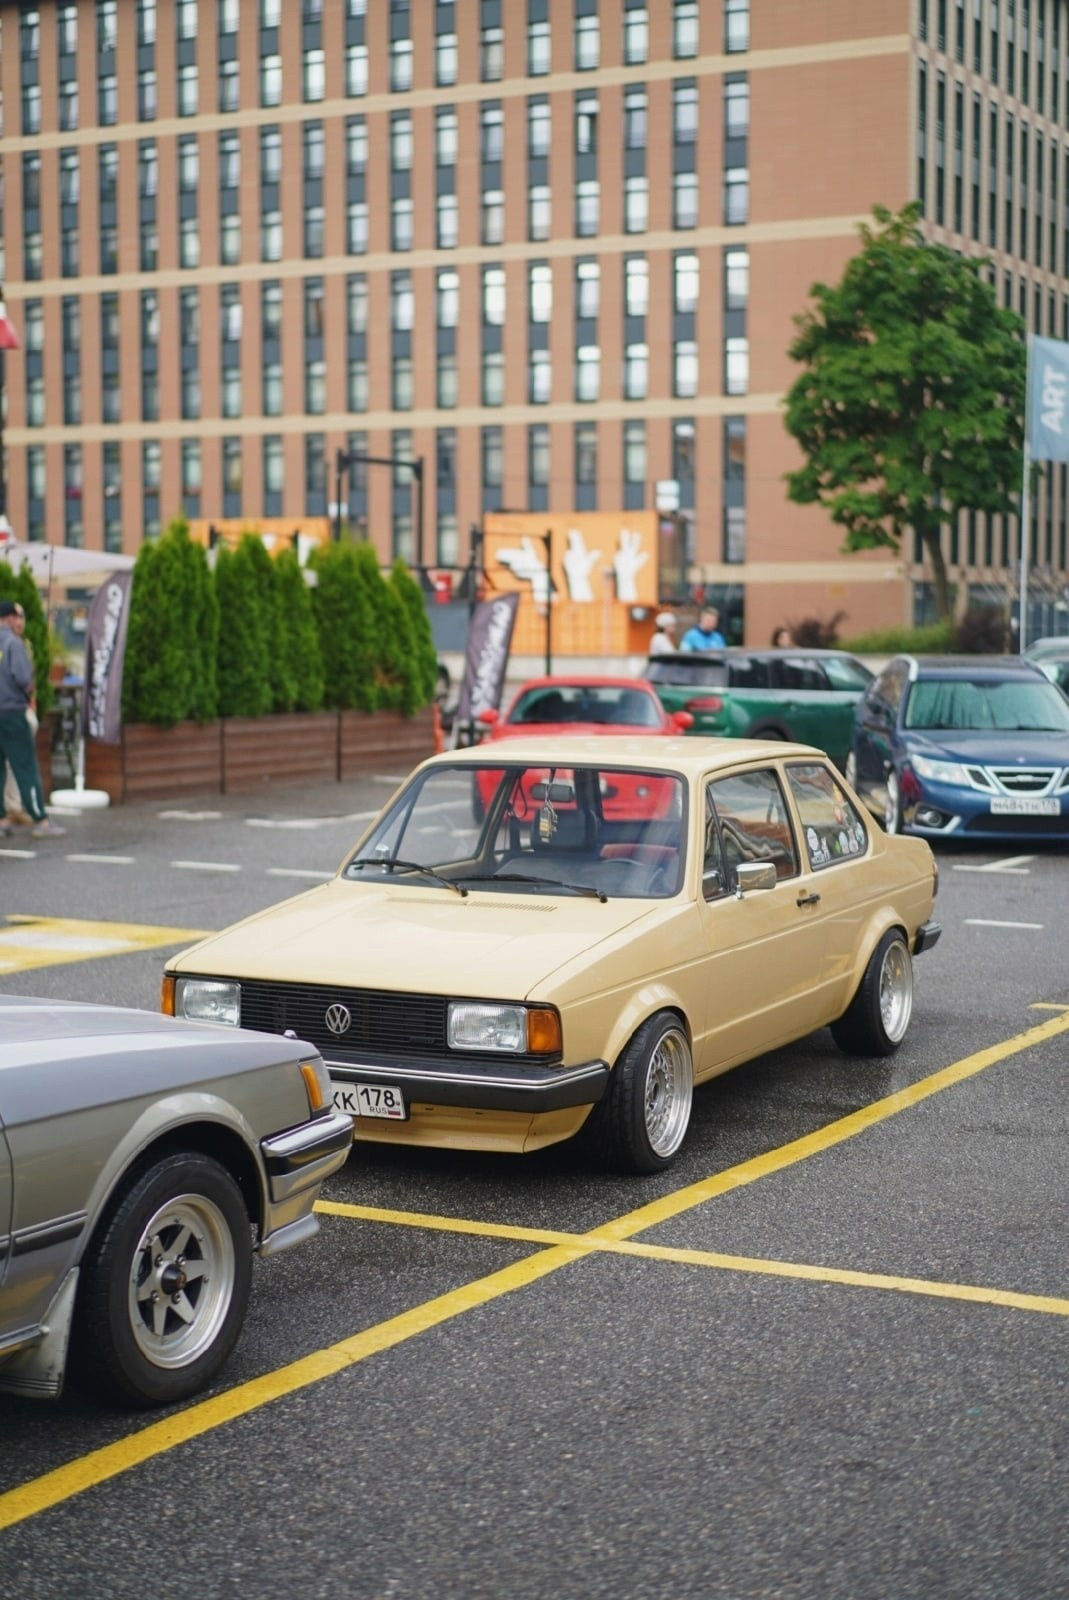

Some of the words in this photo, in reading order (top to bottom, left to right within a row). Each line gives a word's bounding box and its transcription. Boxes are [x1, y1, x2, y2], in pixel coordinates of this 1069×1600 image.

[1040, 363, 1068, 435] ART
[360, 1087, 395, 1108] 178
[369, 1106, 388, 1114] RUS
